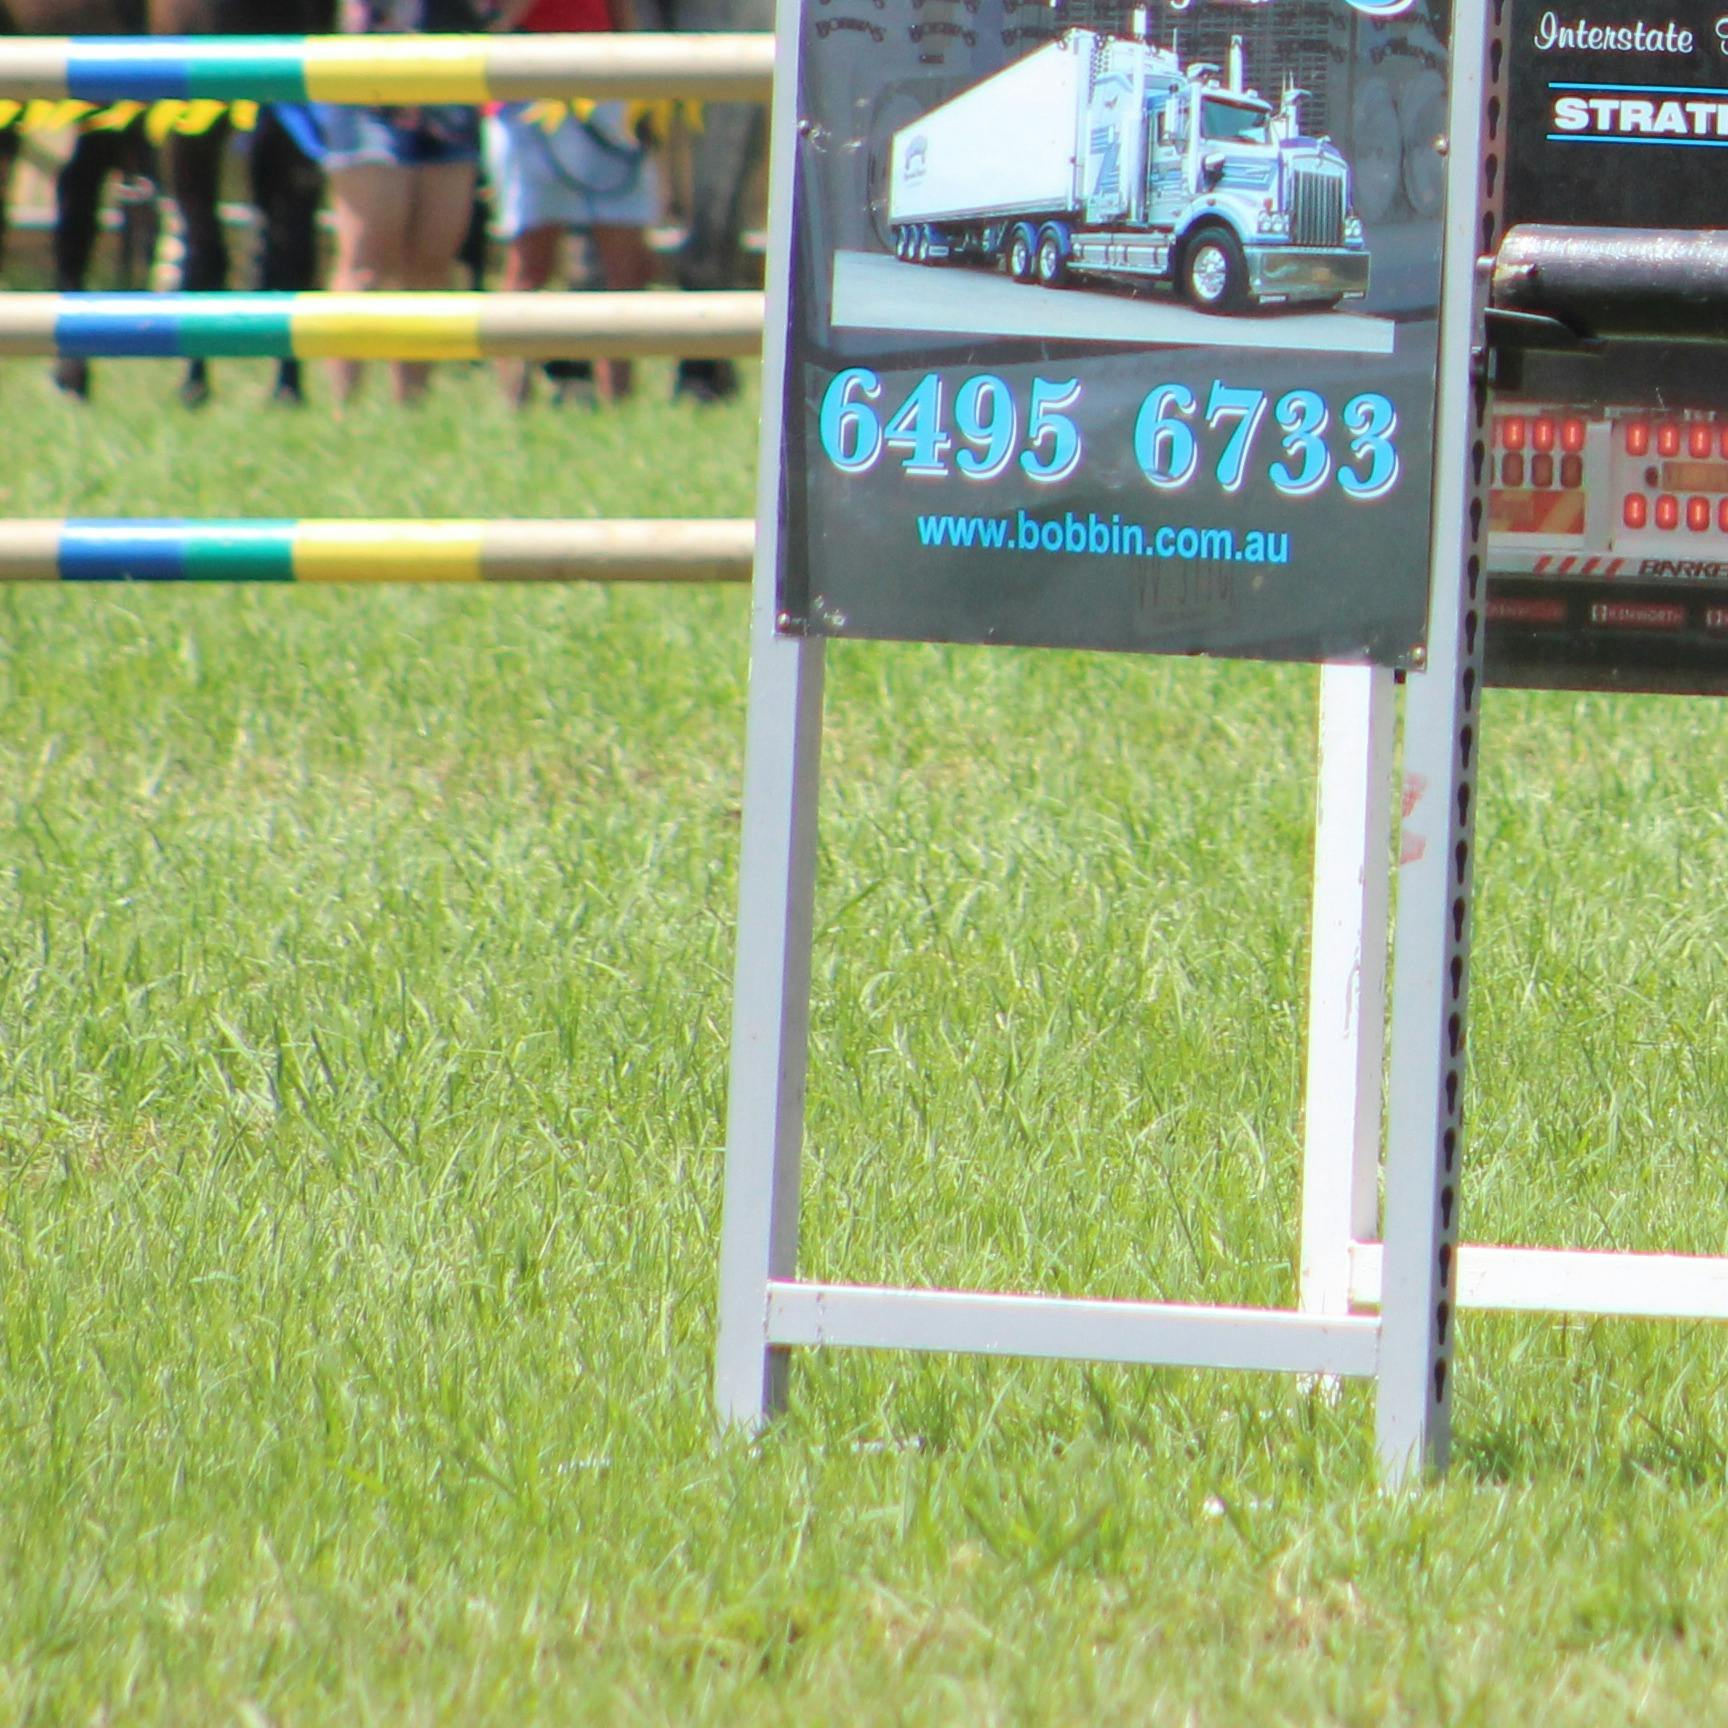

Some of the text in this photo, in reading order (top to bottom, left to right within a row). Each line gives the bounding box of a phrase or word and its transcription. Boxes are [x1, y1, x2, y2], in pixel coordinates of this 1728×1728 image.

[1533, 11, 1694, 53] Interstate
[819, 367, 1400, 499] 6495 6733
[917, 509, 1290, 564] www.bobbin.com.au
